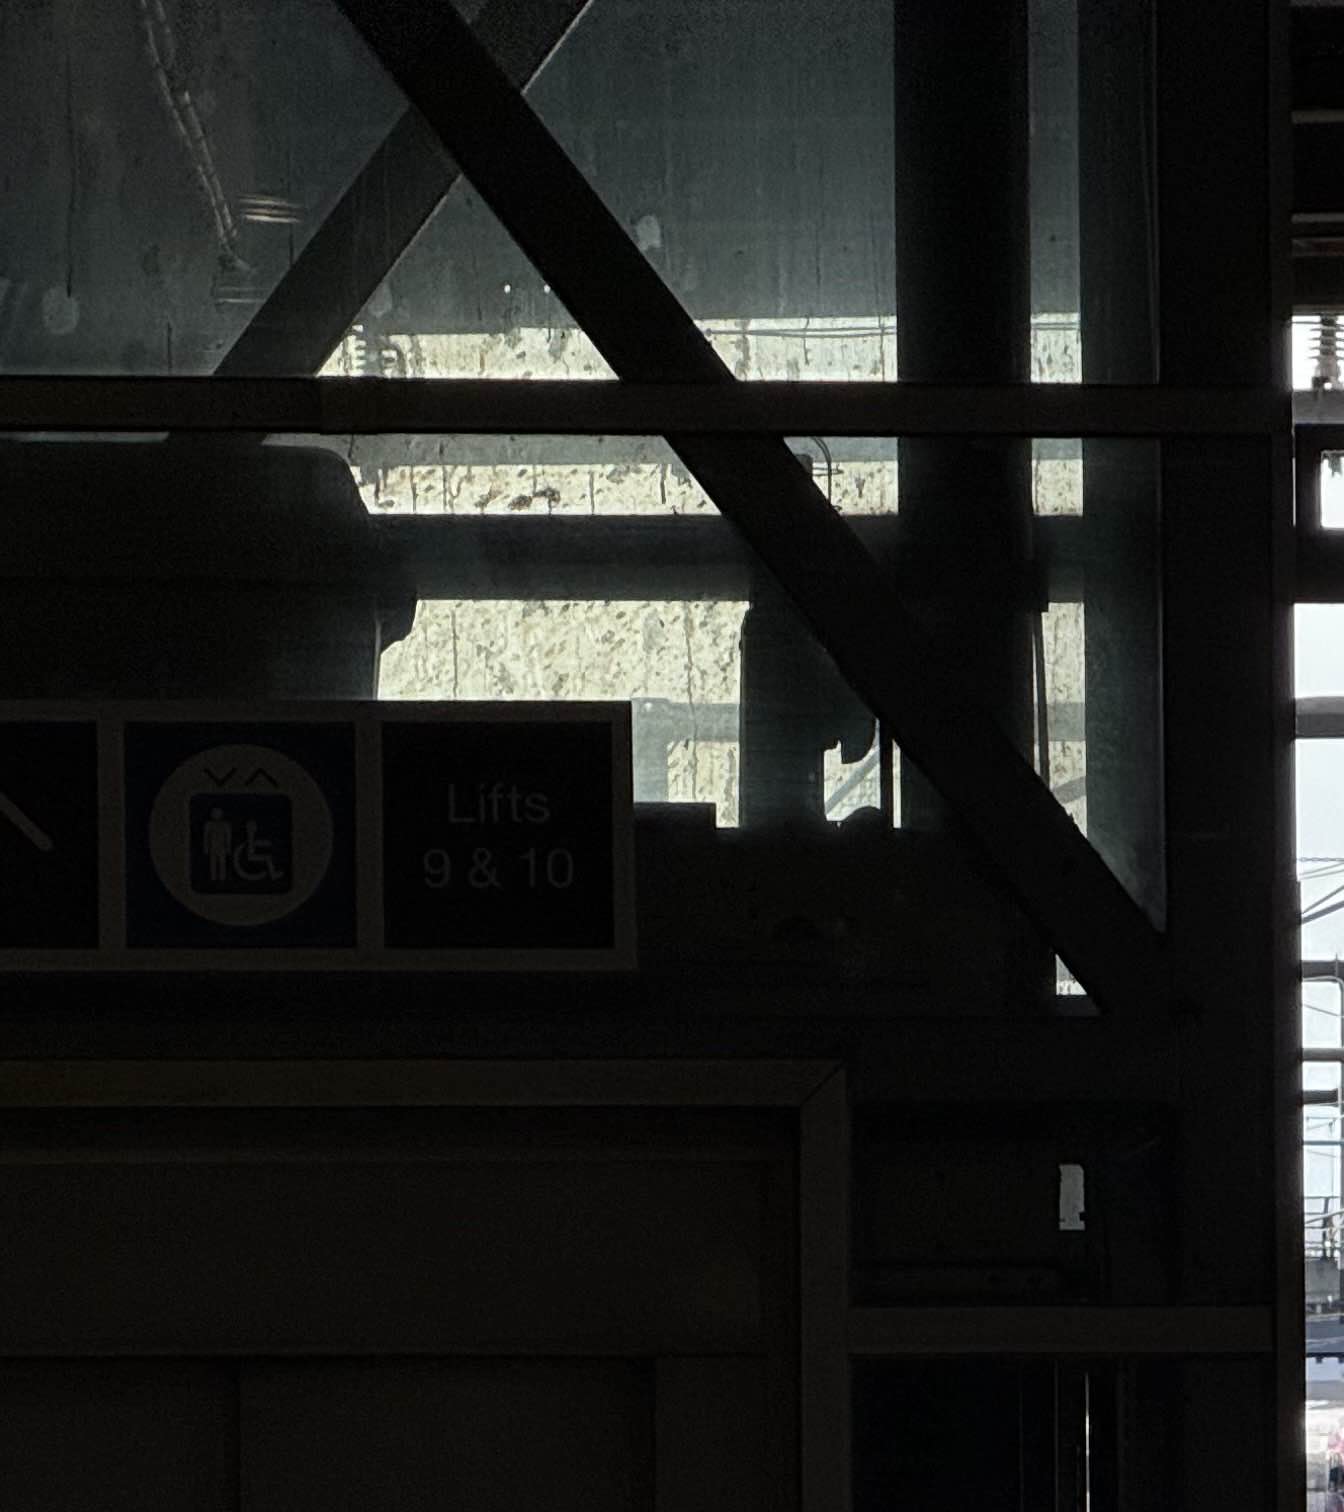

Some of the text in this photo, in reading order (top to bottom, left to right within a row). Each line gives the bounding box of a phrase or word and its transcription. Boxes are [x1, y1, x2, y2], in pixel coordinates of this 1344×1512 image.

[448, 783, 551, 824] Lifts
[423, 847, 575, 889] 9 & 10
